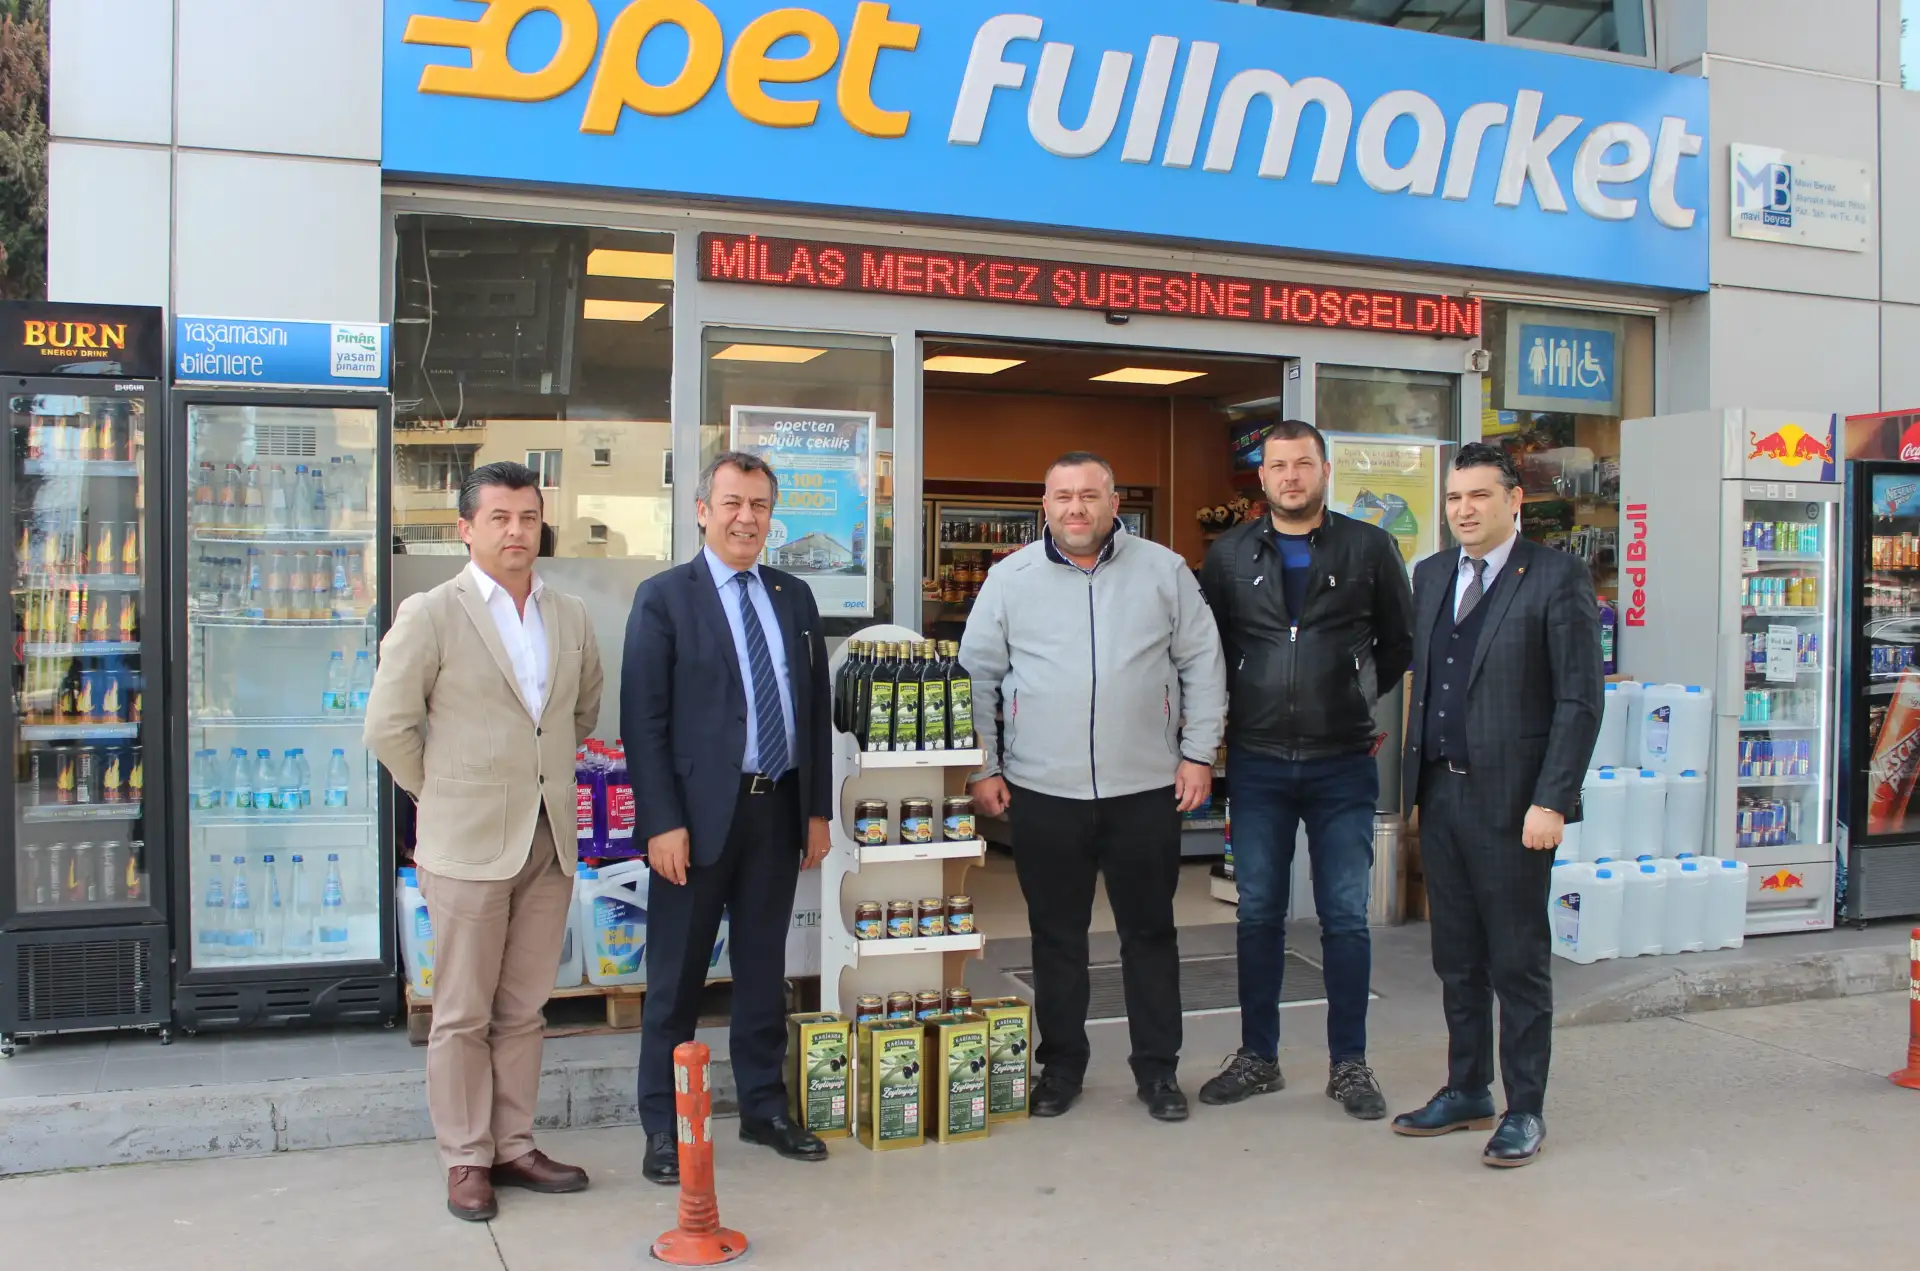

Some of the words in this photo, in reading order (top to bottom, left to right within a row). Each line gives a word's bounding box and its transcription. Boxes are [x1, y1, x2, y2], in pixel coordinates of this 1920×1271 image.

[403, 0, 921, 139] opet
[948, 14, 1702, 230] fullmarket
[1741, 211, 1760, 221] mavi
[1764, 212, 1791, 226] beyaz
[711, 234, 847, 287] MİLAS
[861, 252, 1040, 301] MERKEZ
[1052, 268, 1250, 318] ŞUBESİNE
[23, 320, 128, 350] BURN
[41, 348, 78, 357] ENERGY
[81, 349, 109, 358] DRINK
[336, 352, 376, 363] yaşam
[183, 353, 263, 376] bilenlere
[773, 420, 835, 435] opet'ten
[757, 432, 803, 451] büyük
[806, 436, 851, 452] çekiliş
[792, 472, 823, 489] 100
[1626, 503, 1648, 562] Bull
[843, 600, 865, 609] opet
[1626, 567, 1647, 627] Red
